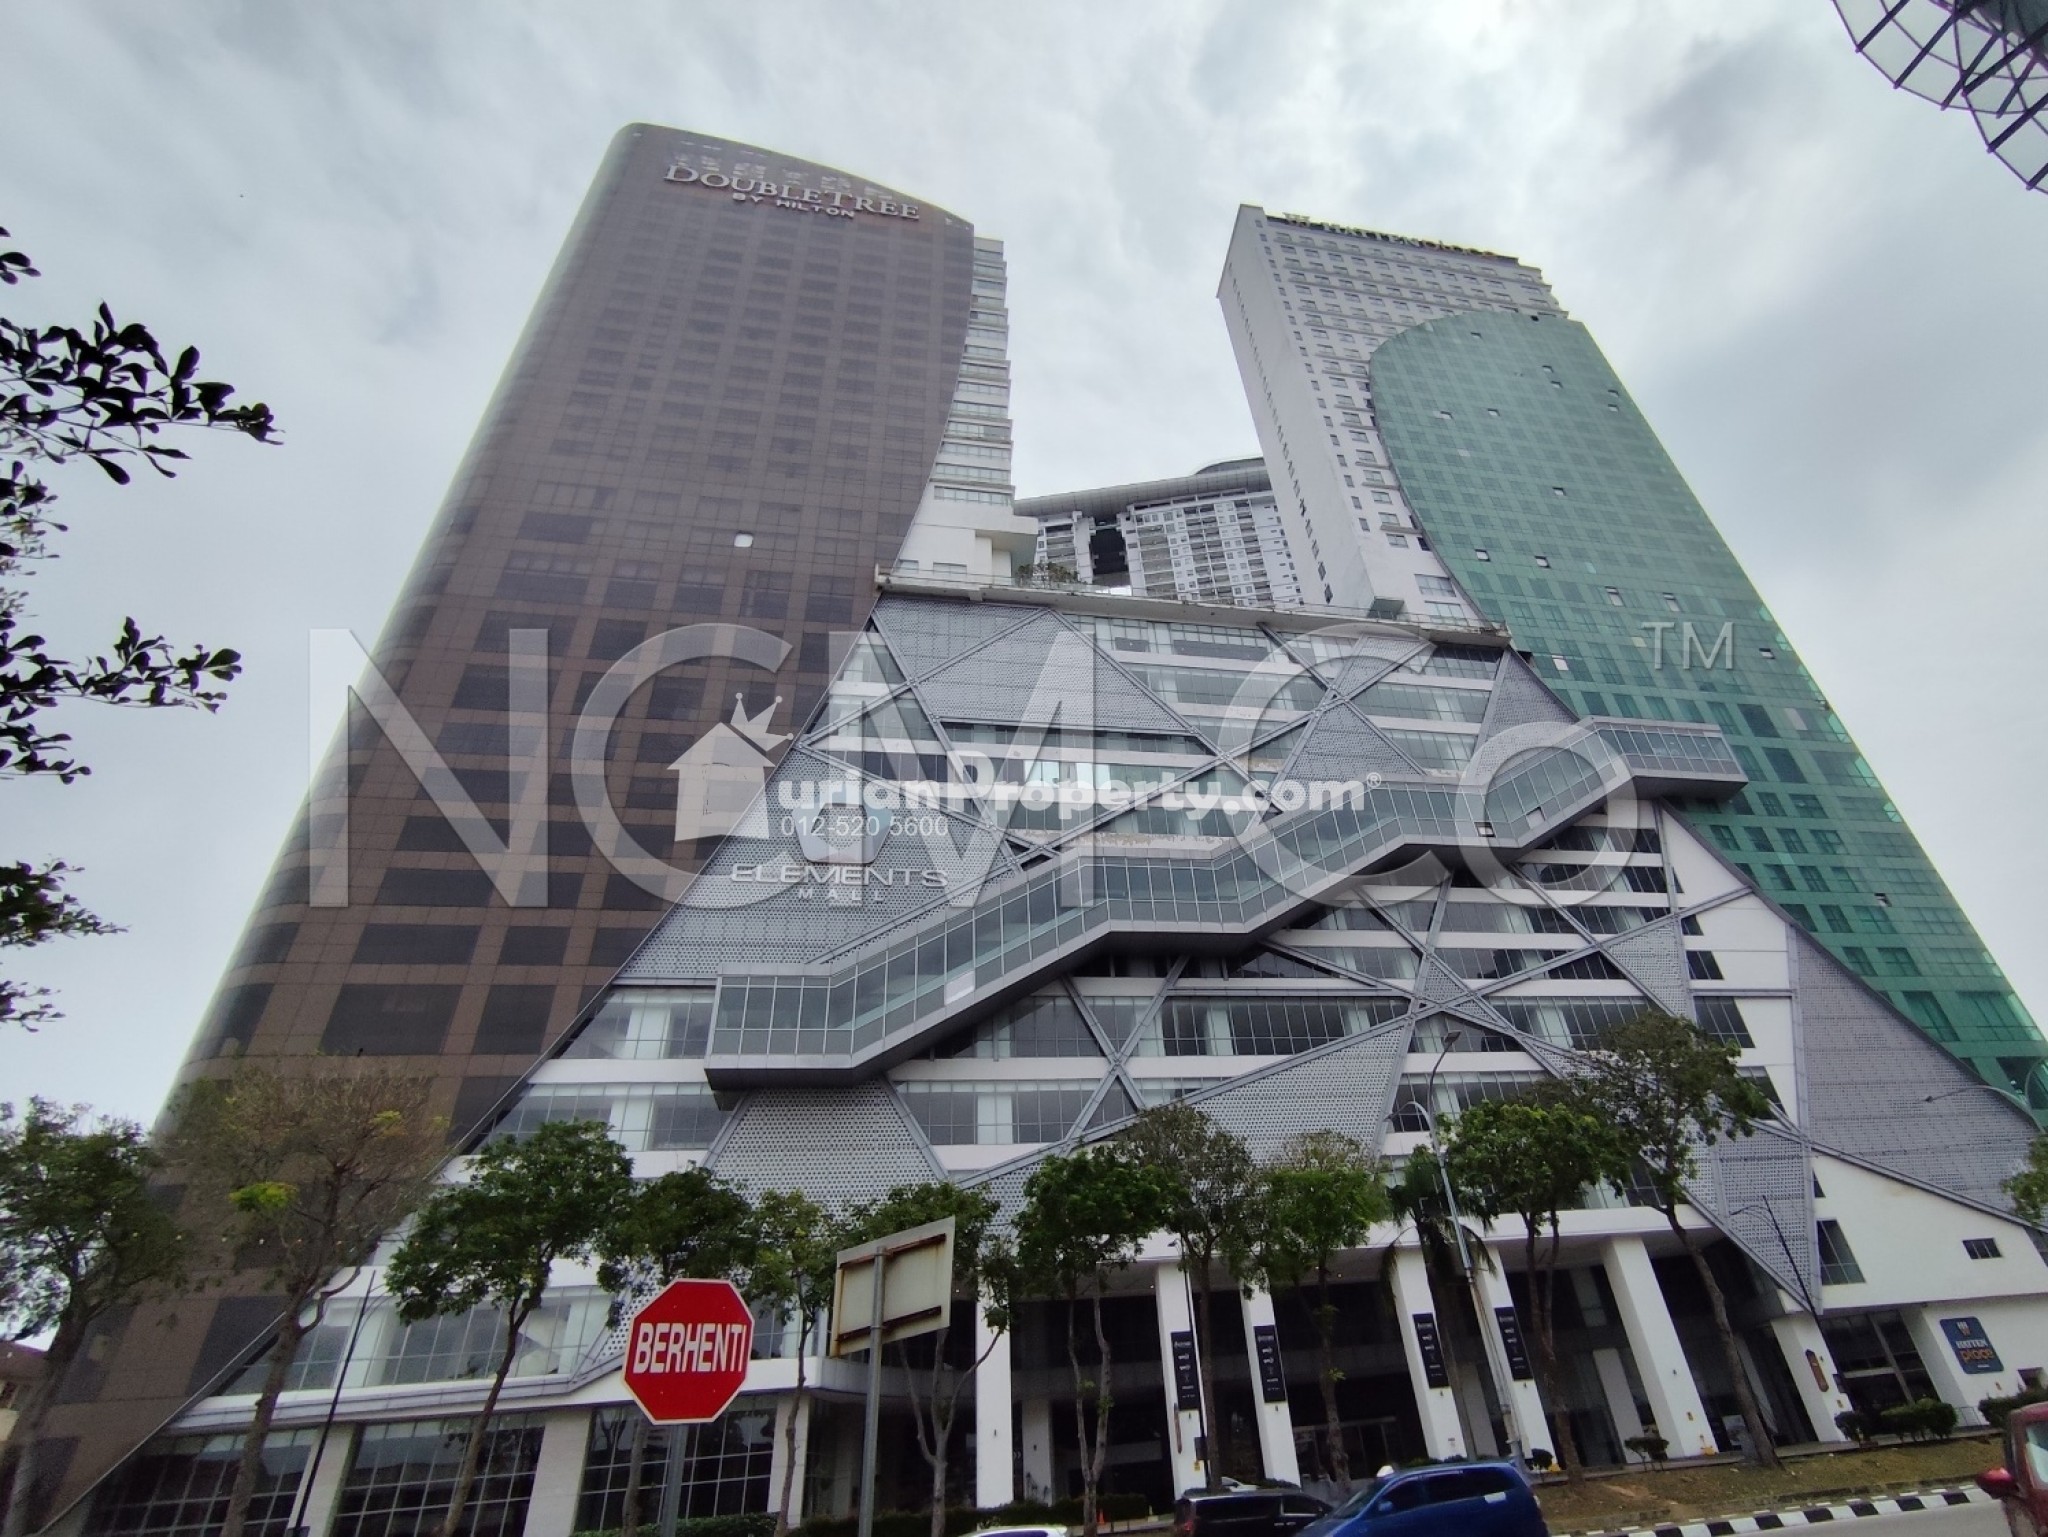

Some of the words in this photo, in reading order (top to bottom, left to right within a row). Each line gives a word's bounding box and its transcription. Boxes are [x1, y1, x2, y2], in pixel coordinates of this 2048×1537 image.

[664, 164, 920, 220] DOUBLETREE
[776, 199, 856, 220] HILTON
[731, 863, 949, 889] ELEMENTS
[799, 887, 888, 903] MALL
[633, 1322, 748, 1375] BERHENTI
